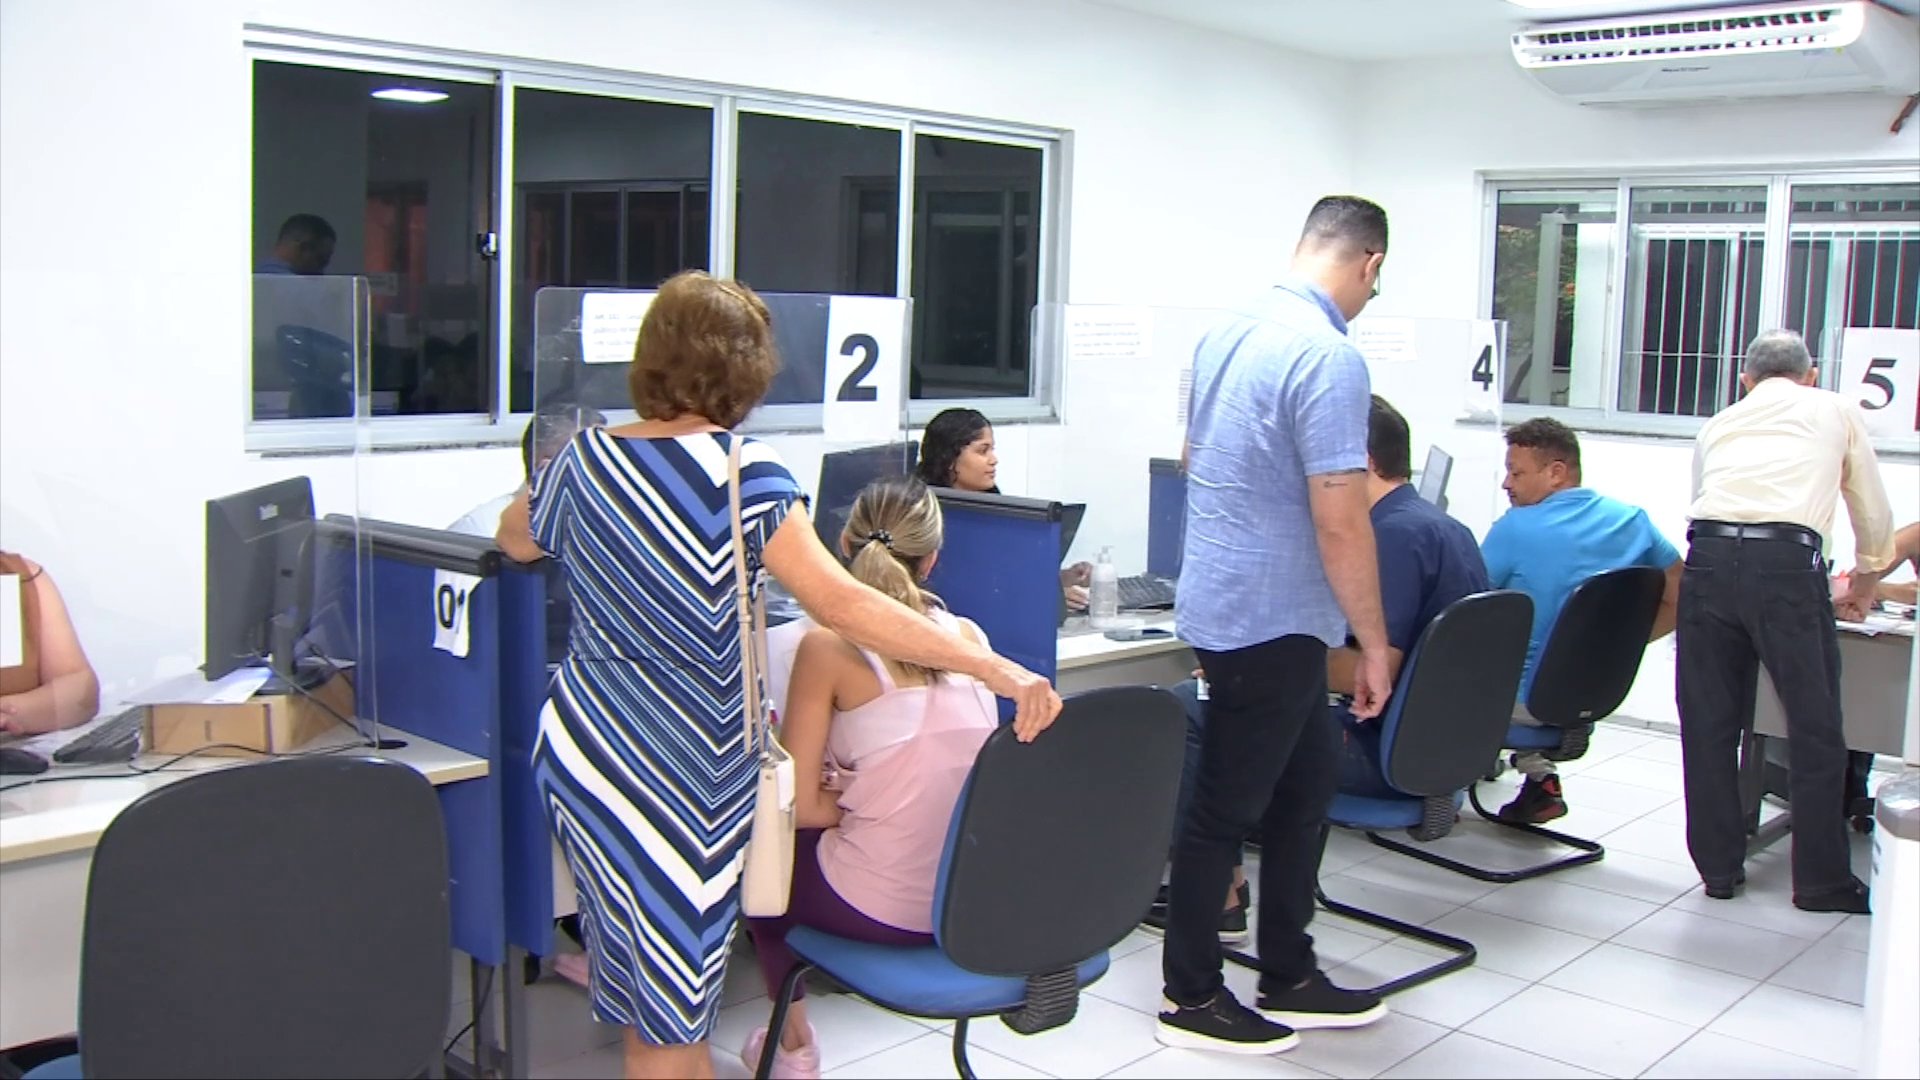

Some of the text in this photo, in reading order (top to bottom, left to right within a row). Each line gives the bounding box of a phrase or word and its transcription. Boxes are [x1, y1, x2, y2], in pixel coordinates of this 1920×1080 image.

[836, 333, 879, 402] 2
[1472, 344, 1493, 391] 4
[1860, 357, 1897, 410] 5
